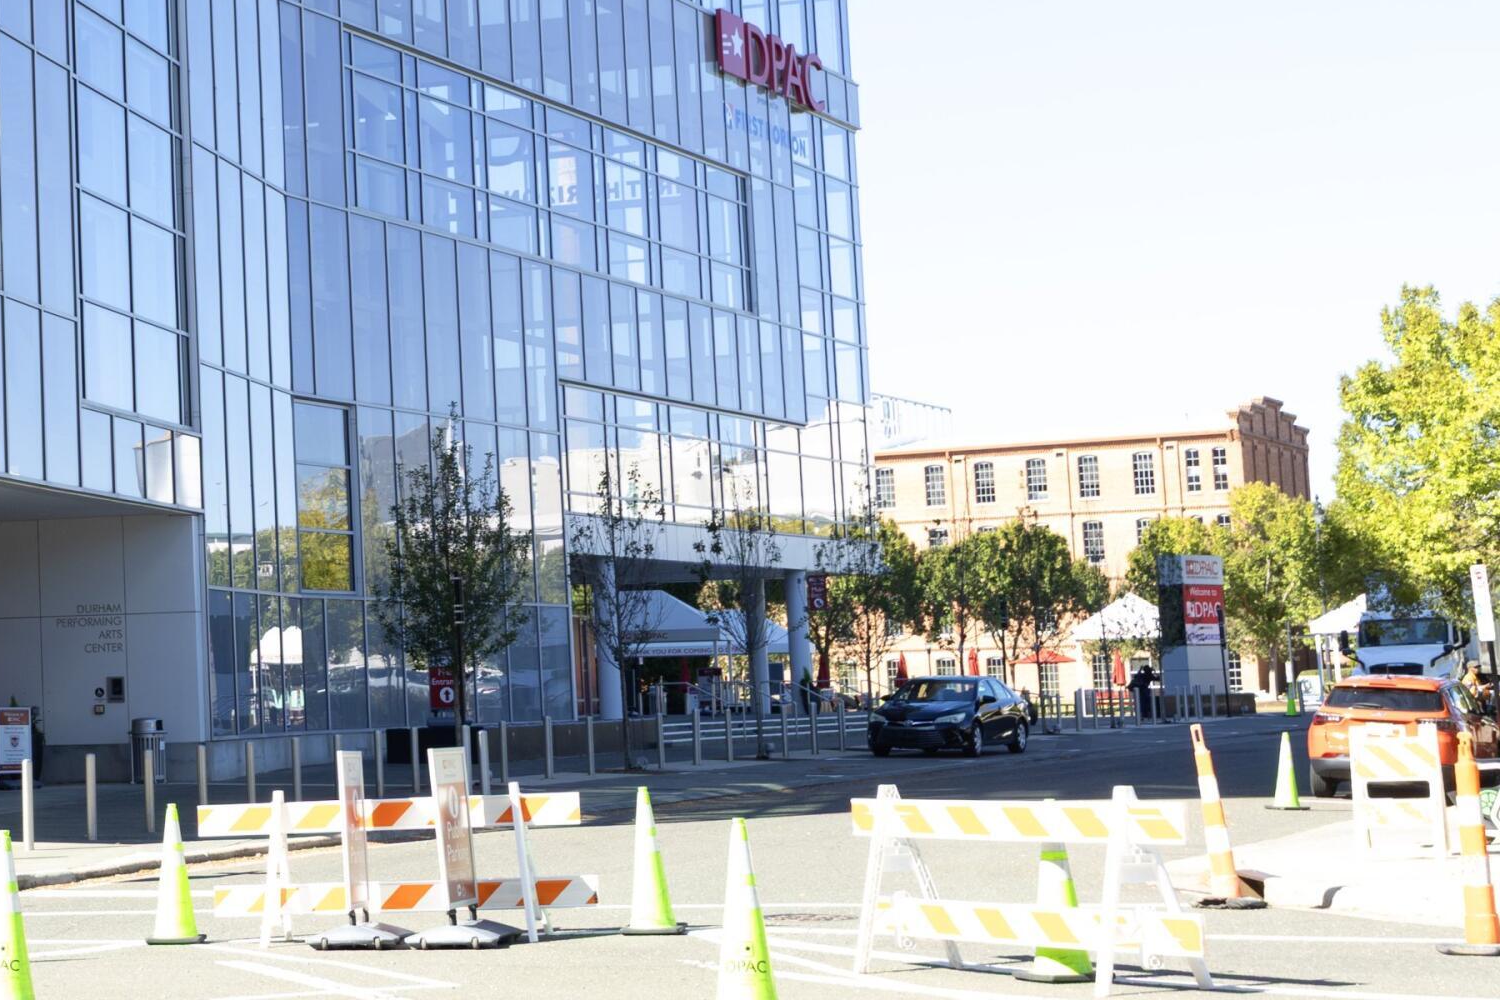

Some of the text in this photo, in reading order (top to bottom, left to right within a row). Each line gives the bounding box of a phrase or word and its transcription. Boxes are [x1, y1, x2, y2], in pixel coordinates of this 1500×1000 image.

[743, 22, 825, 112] DPAC
[76, 603, 122, 614] DURHAM
[1195, 601, 1221, 618] DPAC
[56, 615, 123, 629] PERFORMING
[98, 628, 123, 640] ARTS
[84, 642, 124, 654] CENTER
